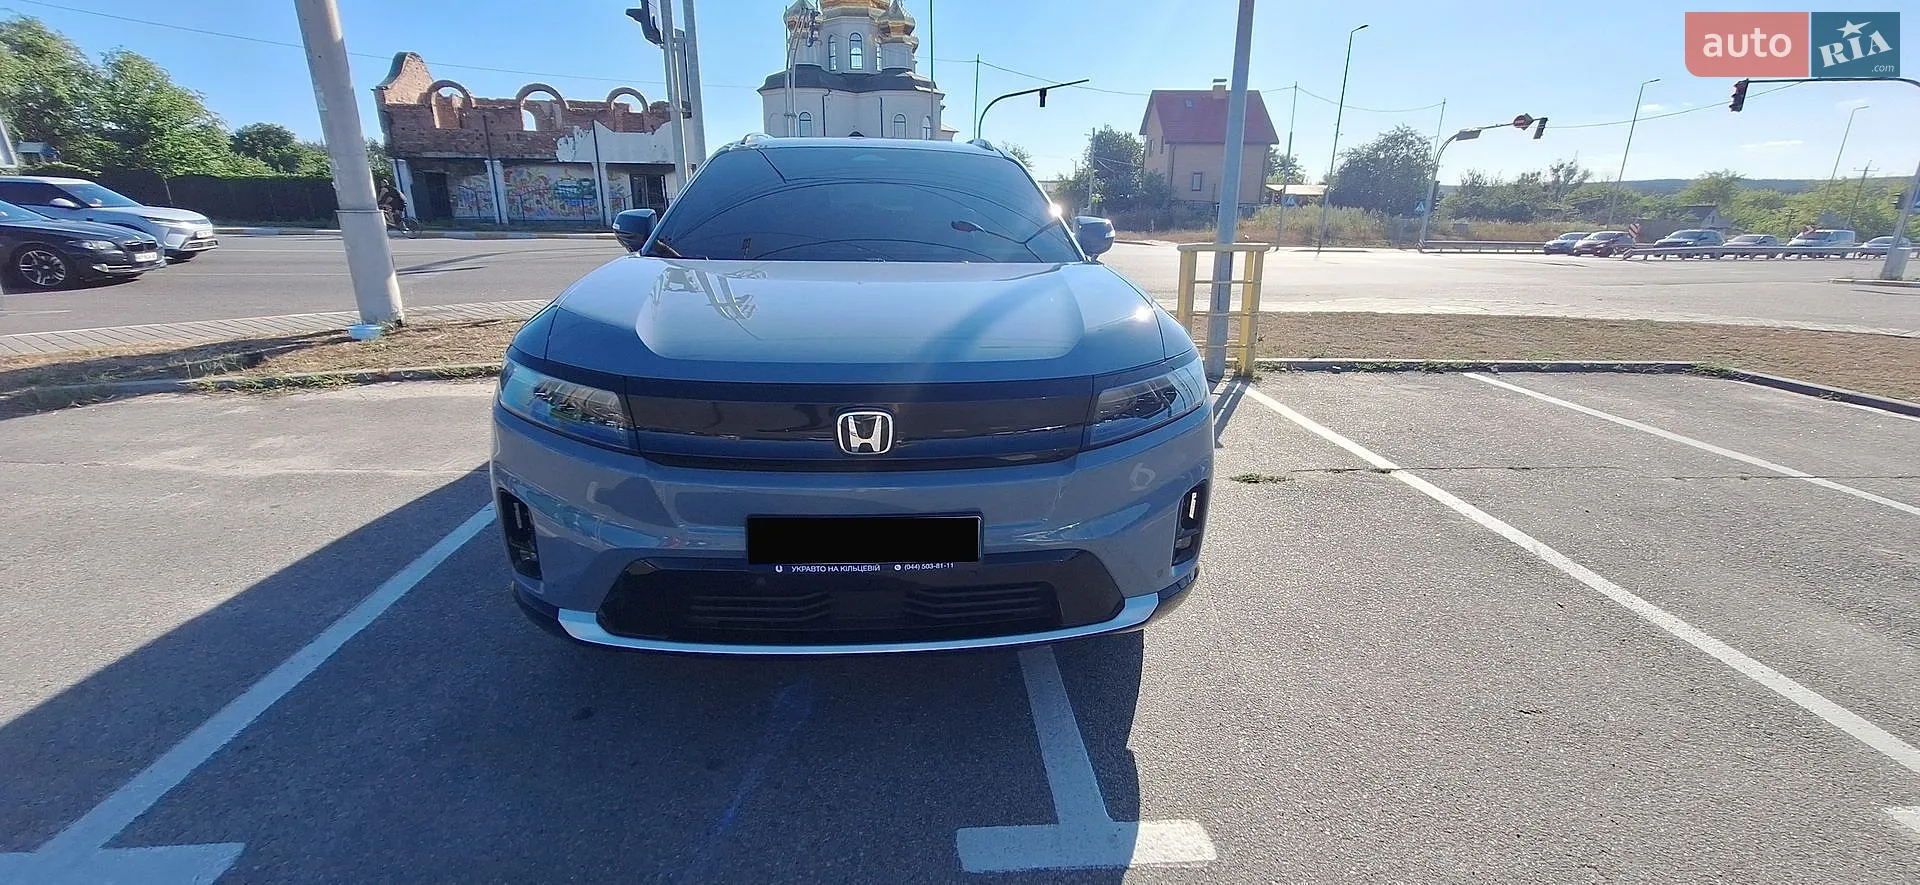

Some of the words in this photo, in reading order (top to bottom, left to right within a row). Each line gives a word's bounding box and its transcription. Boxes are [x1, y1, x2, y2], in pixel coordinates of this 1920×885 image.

[791, 565, 827, 573] УКРАВТО
[827, 565, 839, 573] НА
[840, 564, 880, 573] КІЛЬЦЕВІЙ
[904, 563, 920, 571] (044)
